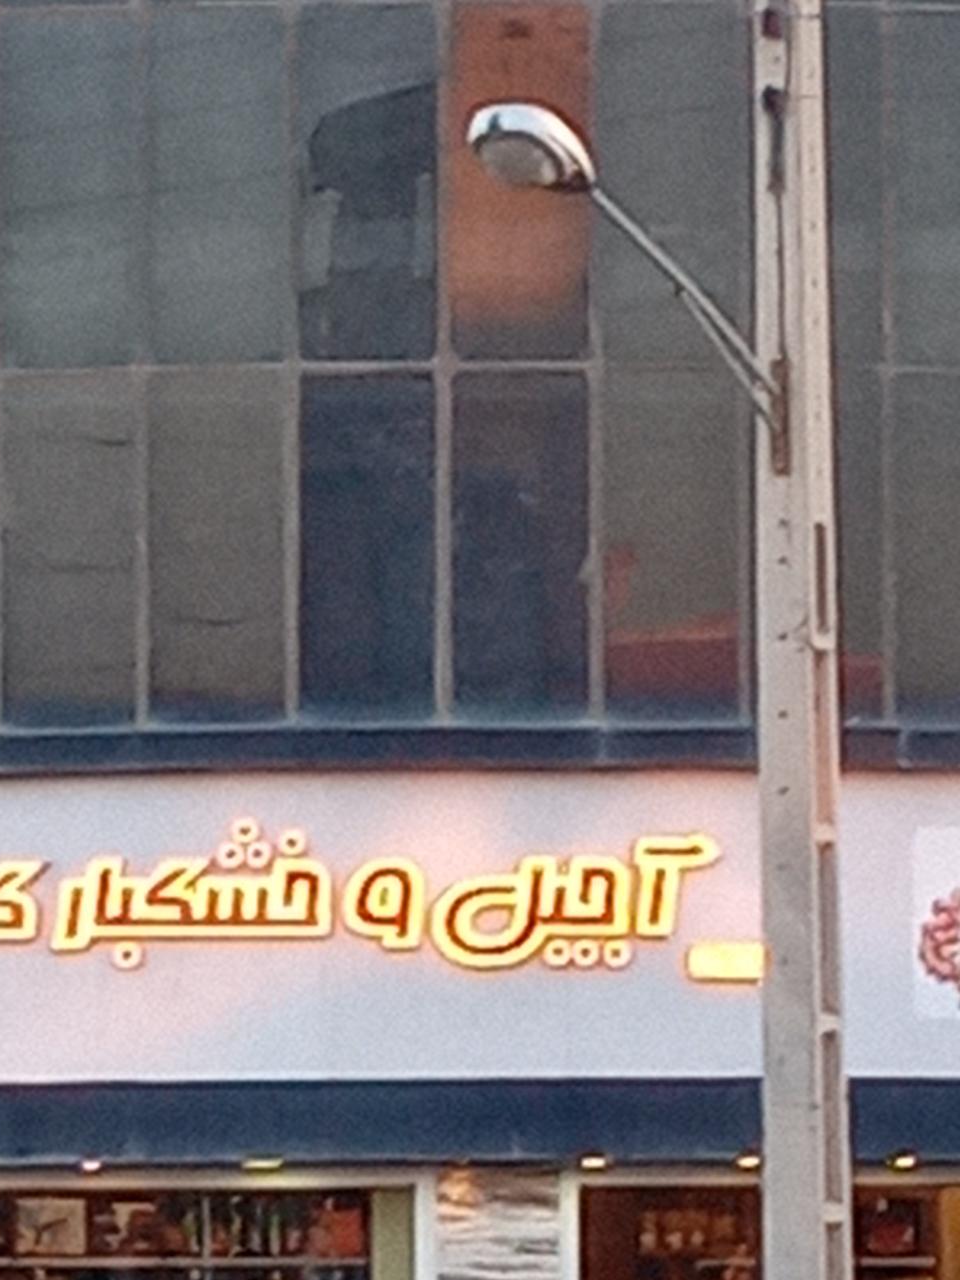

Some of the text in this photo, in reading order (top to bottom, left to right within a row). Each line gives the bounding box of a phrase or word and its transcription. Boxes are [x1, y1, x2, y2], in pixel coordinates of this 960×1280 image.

[50, 815, 331, 969] خشکبار
[343, 850, 426, 950] و
[432, 835, 720, 970] آجیل
